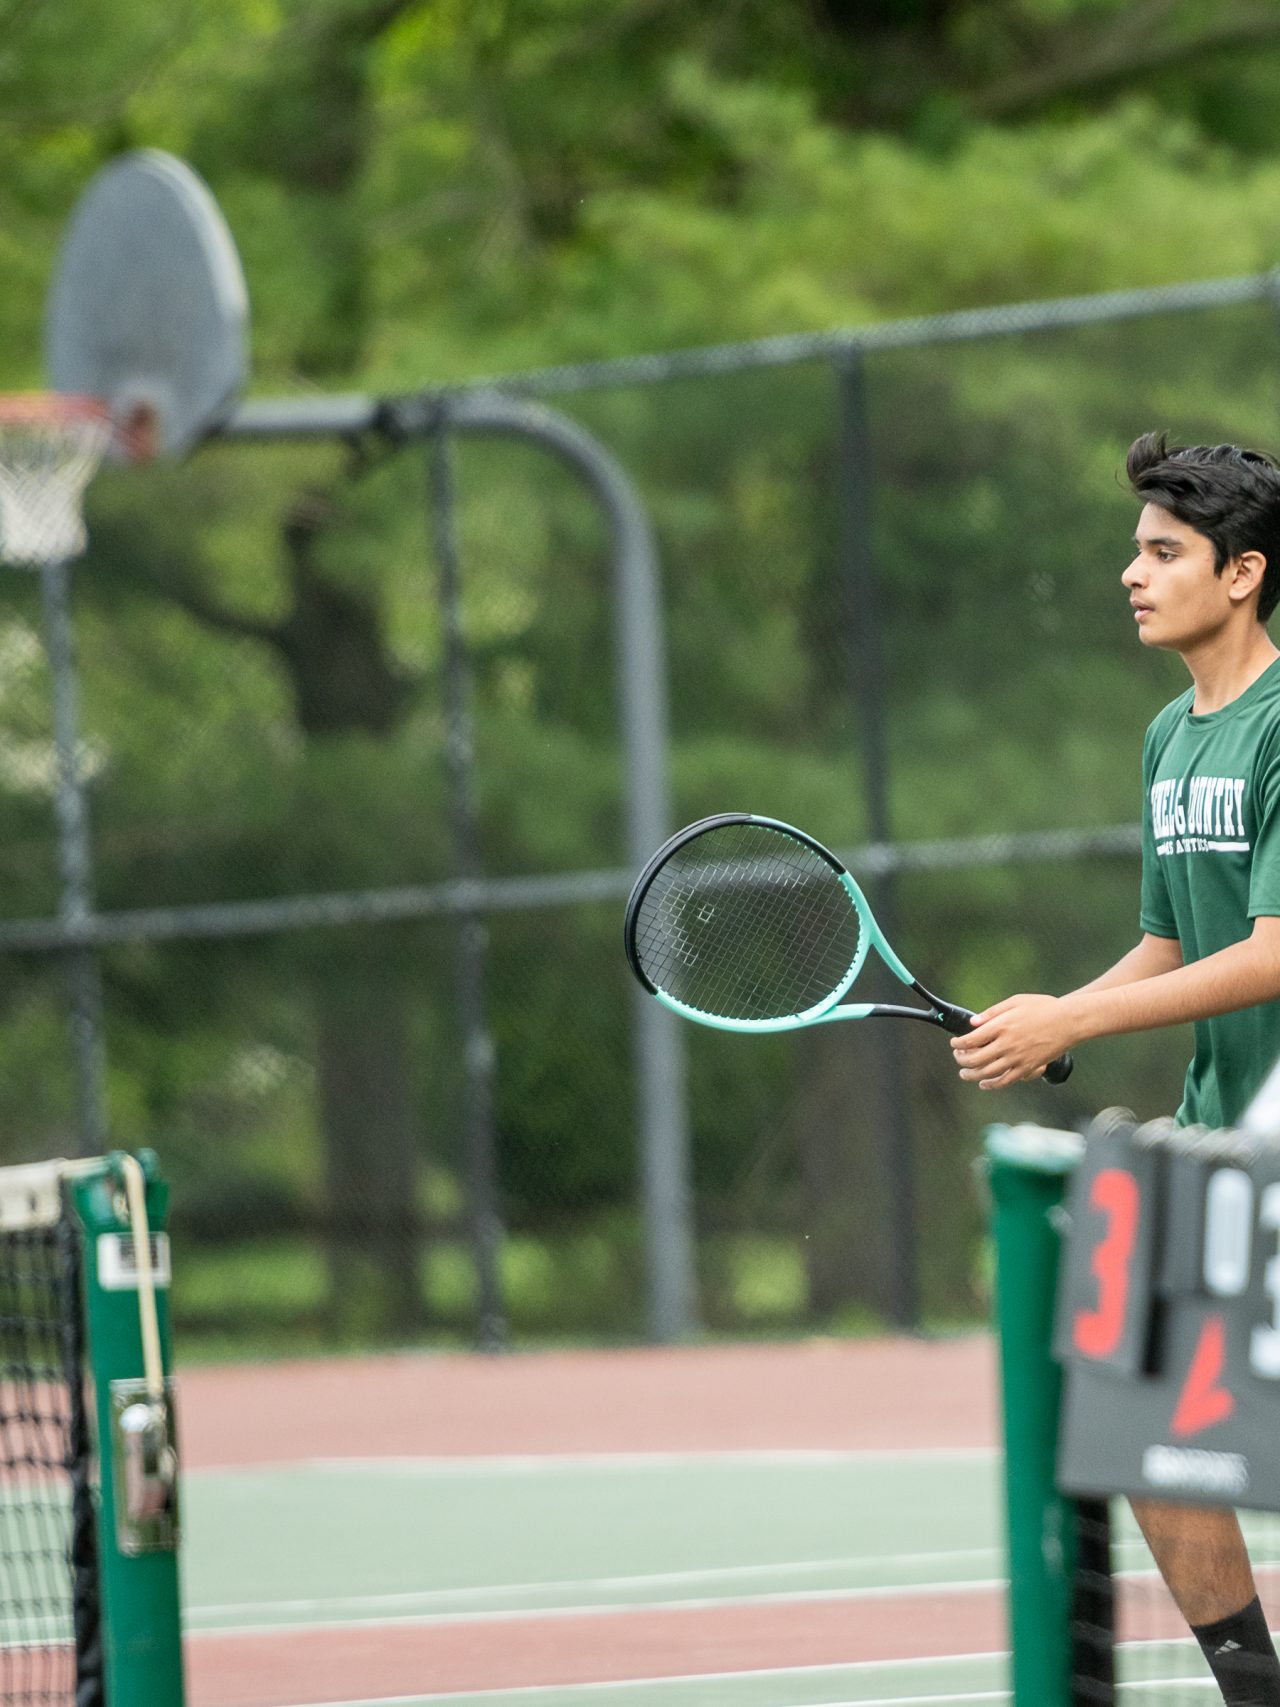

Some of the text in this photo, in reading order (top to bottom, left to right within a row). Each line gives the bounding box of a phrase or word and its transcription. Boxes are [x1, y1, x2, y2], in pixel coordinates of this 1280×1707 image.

[1188, 777, 1245, 836] COUNTRY
[1074, 1169, 1139, 1357] 3
[1205, 1168, 1252, 1297] 0
